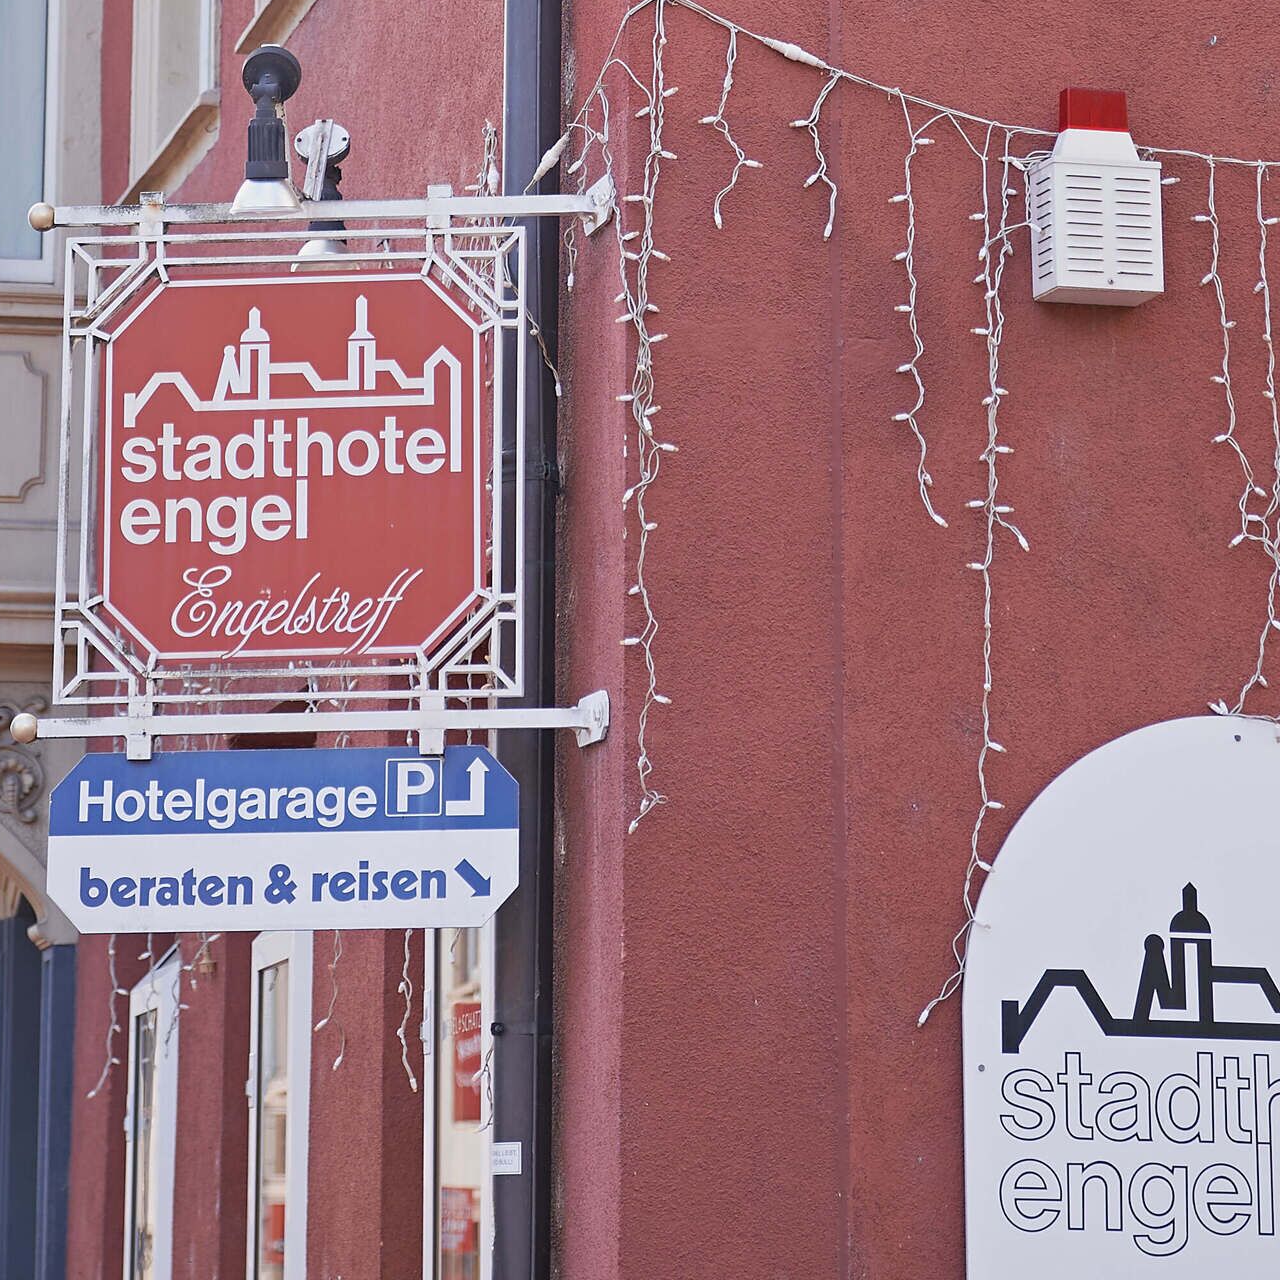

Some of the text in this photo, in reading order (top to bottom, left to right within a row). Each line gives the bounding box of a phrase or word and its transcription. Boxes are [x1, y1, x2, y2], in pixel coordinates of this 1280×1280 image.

[121, 416, 461, 484] stadthotel
[121, 480, 308, 554] engel
[172, 566, 423, 657] Engelstreff
[77, 777, 377, 830] Hotelgarage
[80, 860, 447, 908] beraten & reisen
[999, 1142, 1275, 1257] engel
